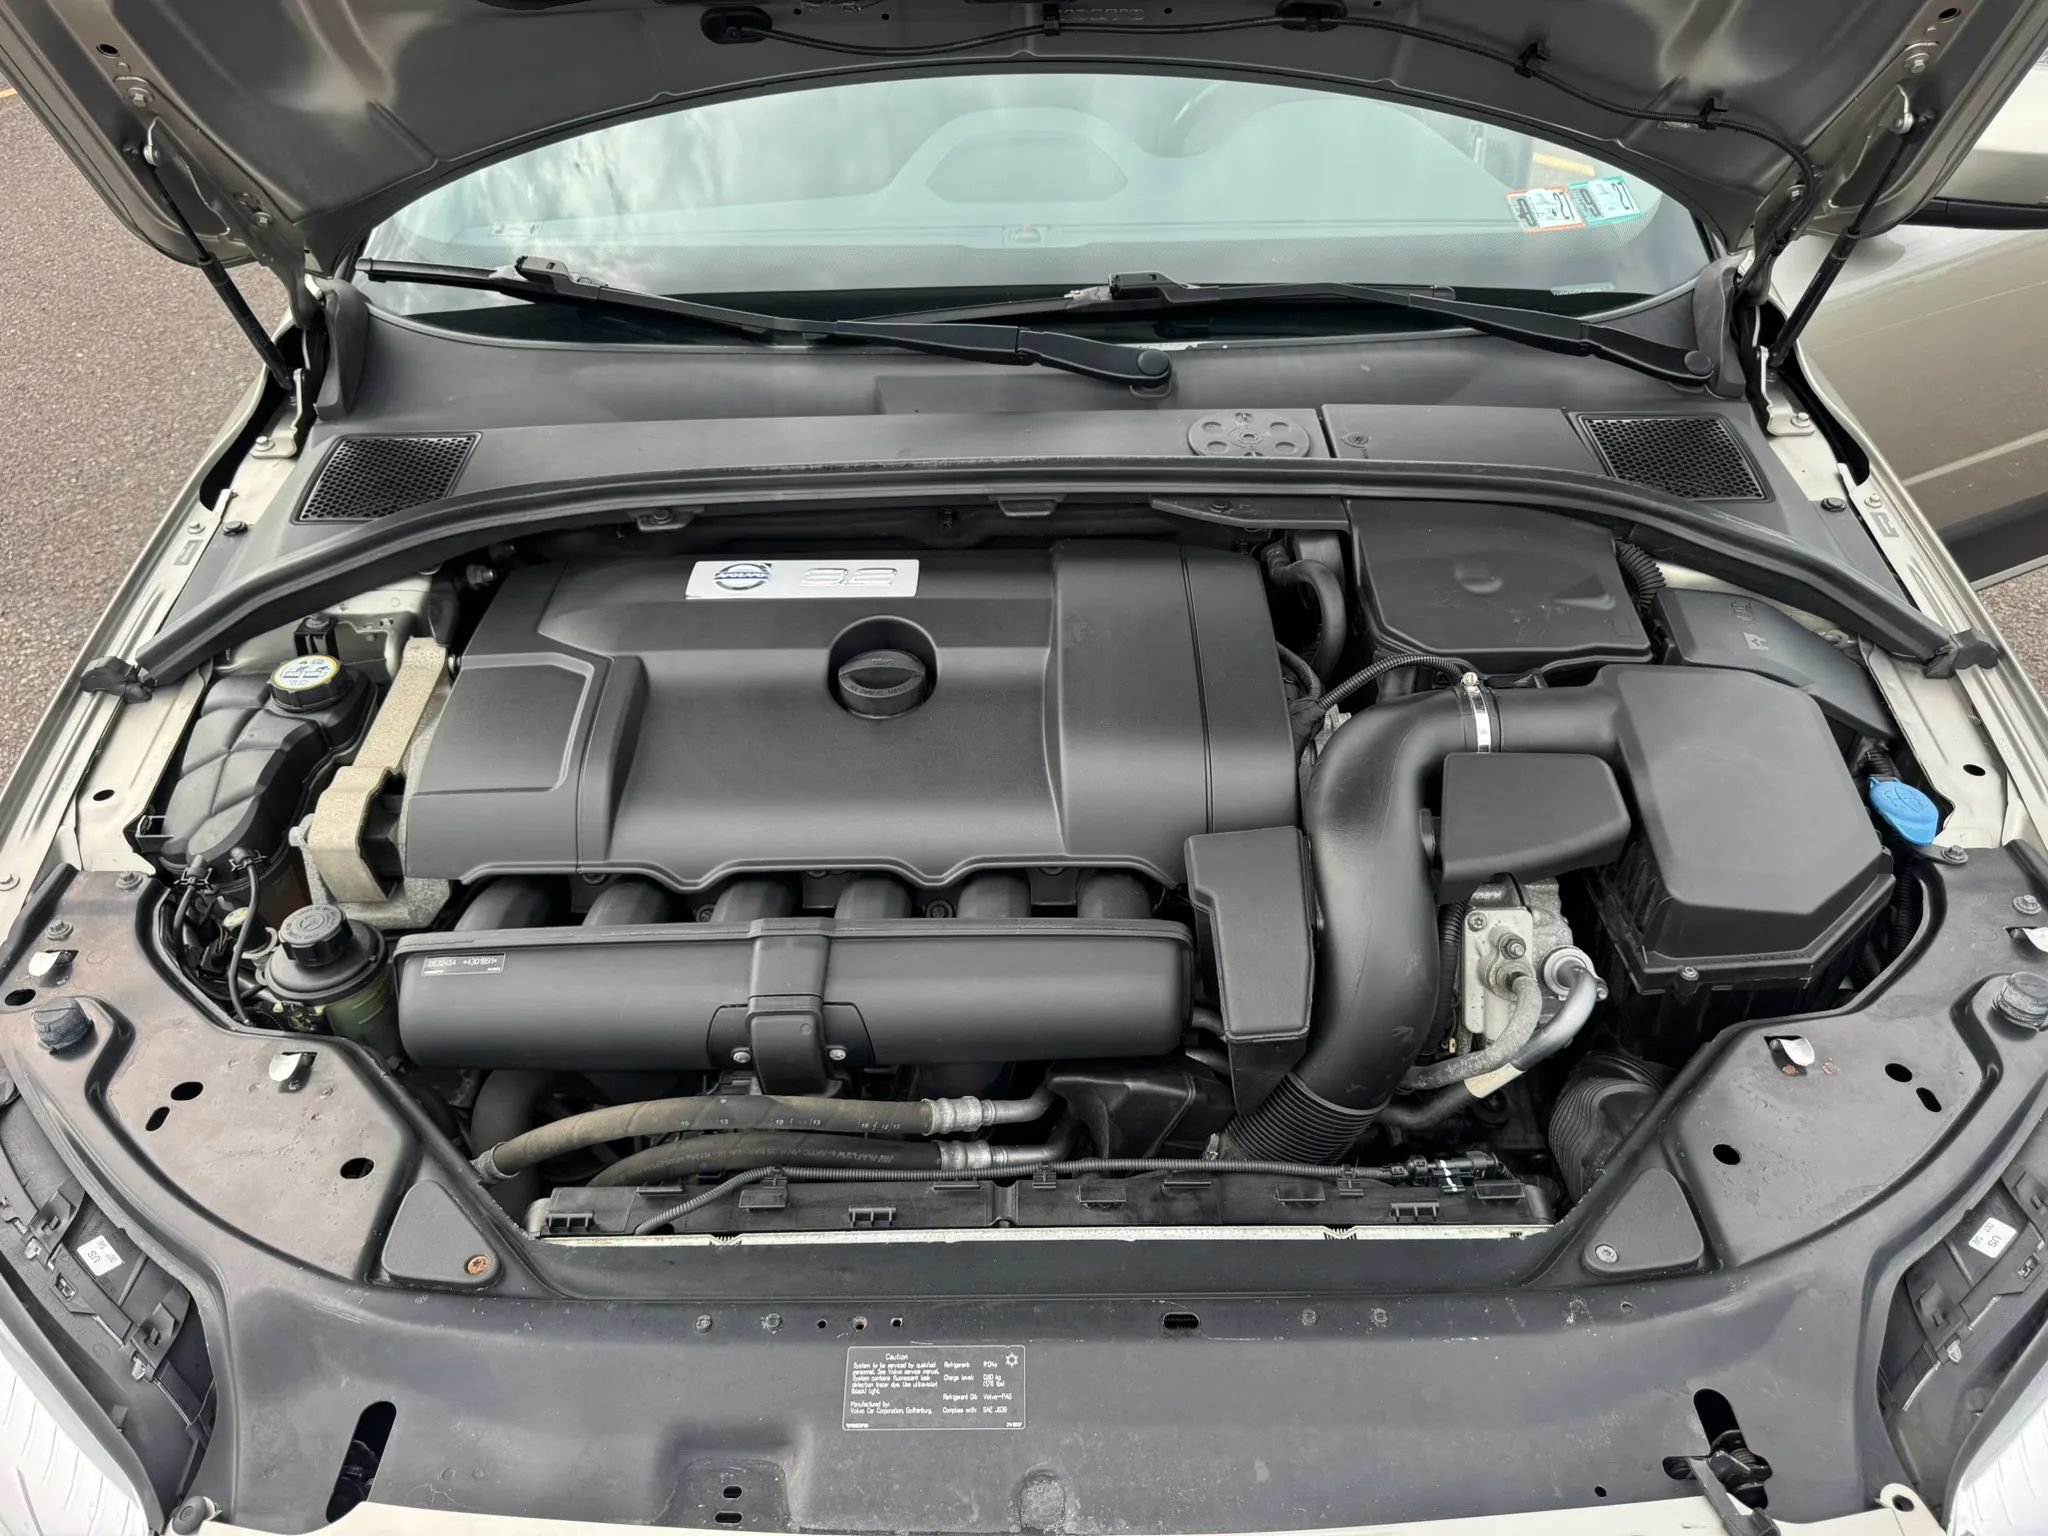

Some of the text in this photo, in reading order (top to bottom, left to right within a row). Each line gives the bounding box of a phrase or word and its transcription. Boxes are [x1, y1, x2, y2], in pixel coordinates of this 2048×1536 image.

[1611, 181, 1635, 211] 27
[1987, 1235, 2001, 1248] US
[87, 1250, 101, 1263] US
[885, 1353, 909, 1361] Caution
[908, 1362, 914, 1370] by
[943, 1374, 959, 1382] Charge
